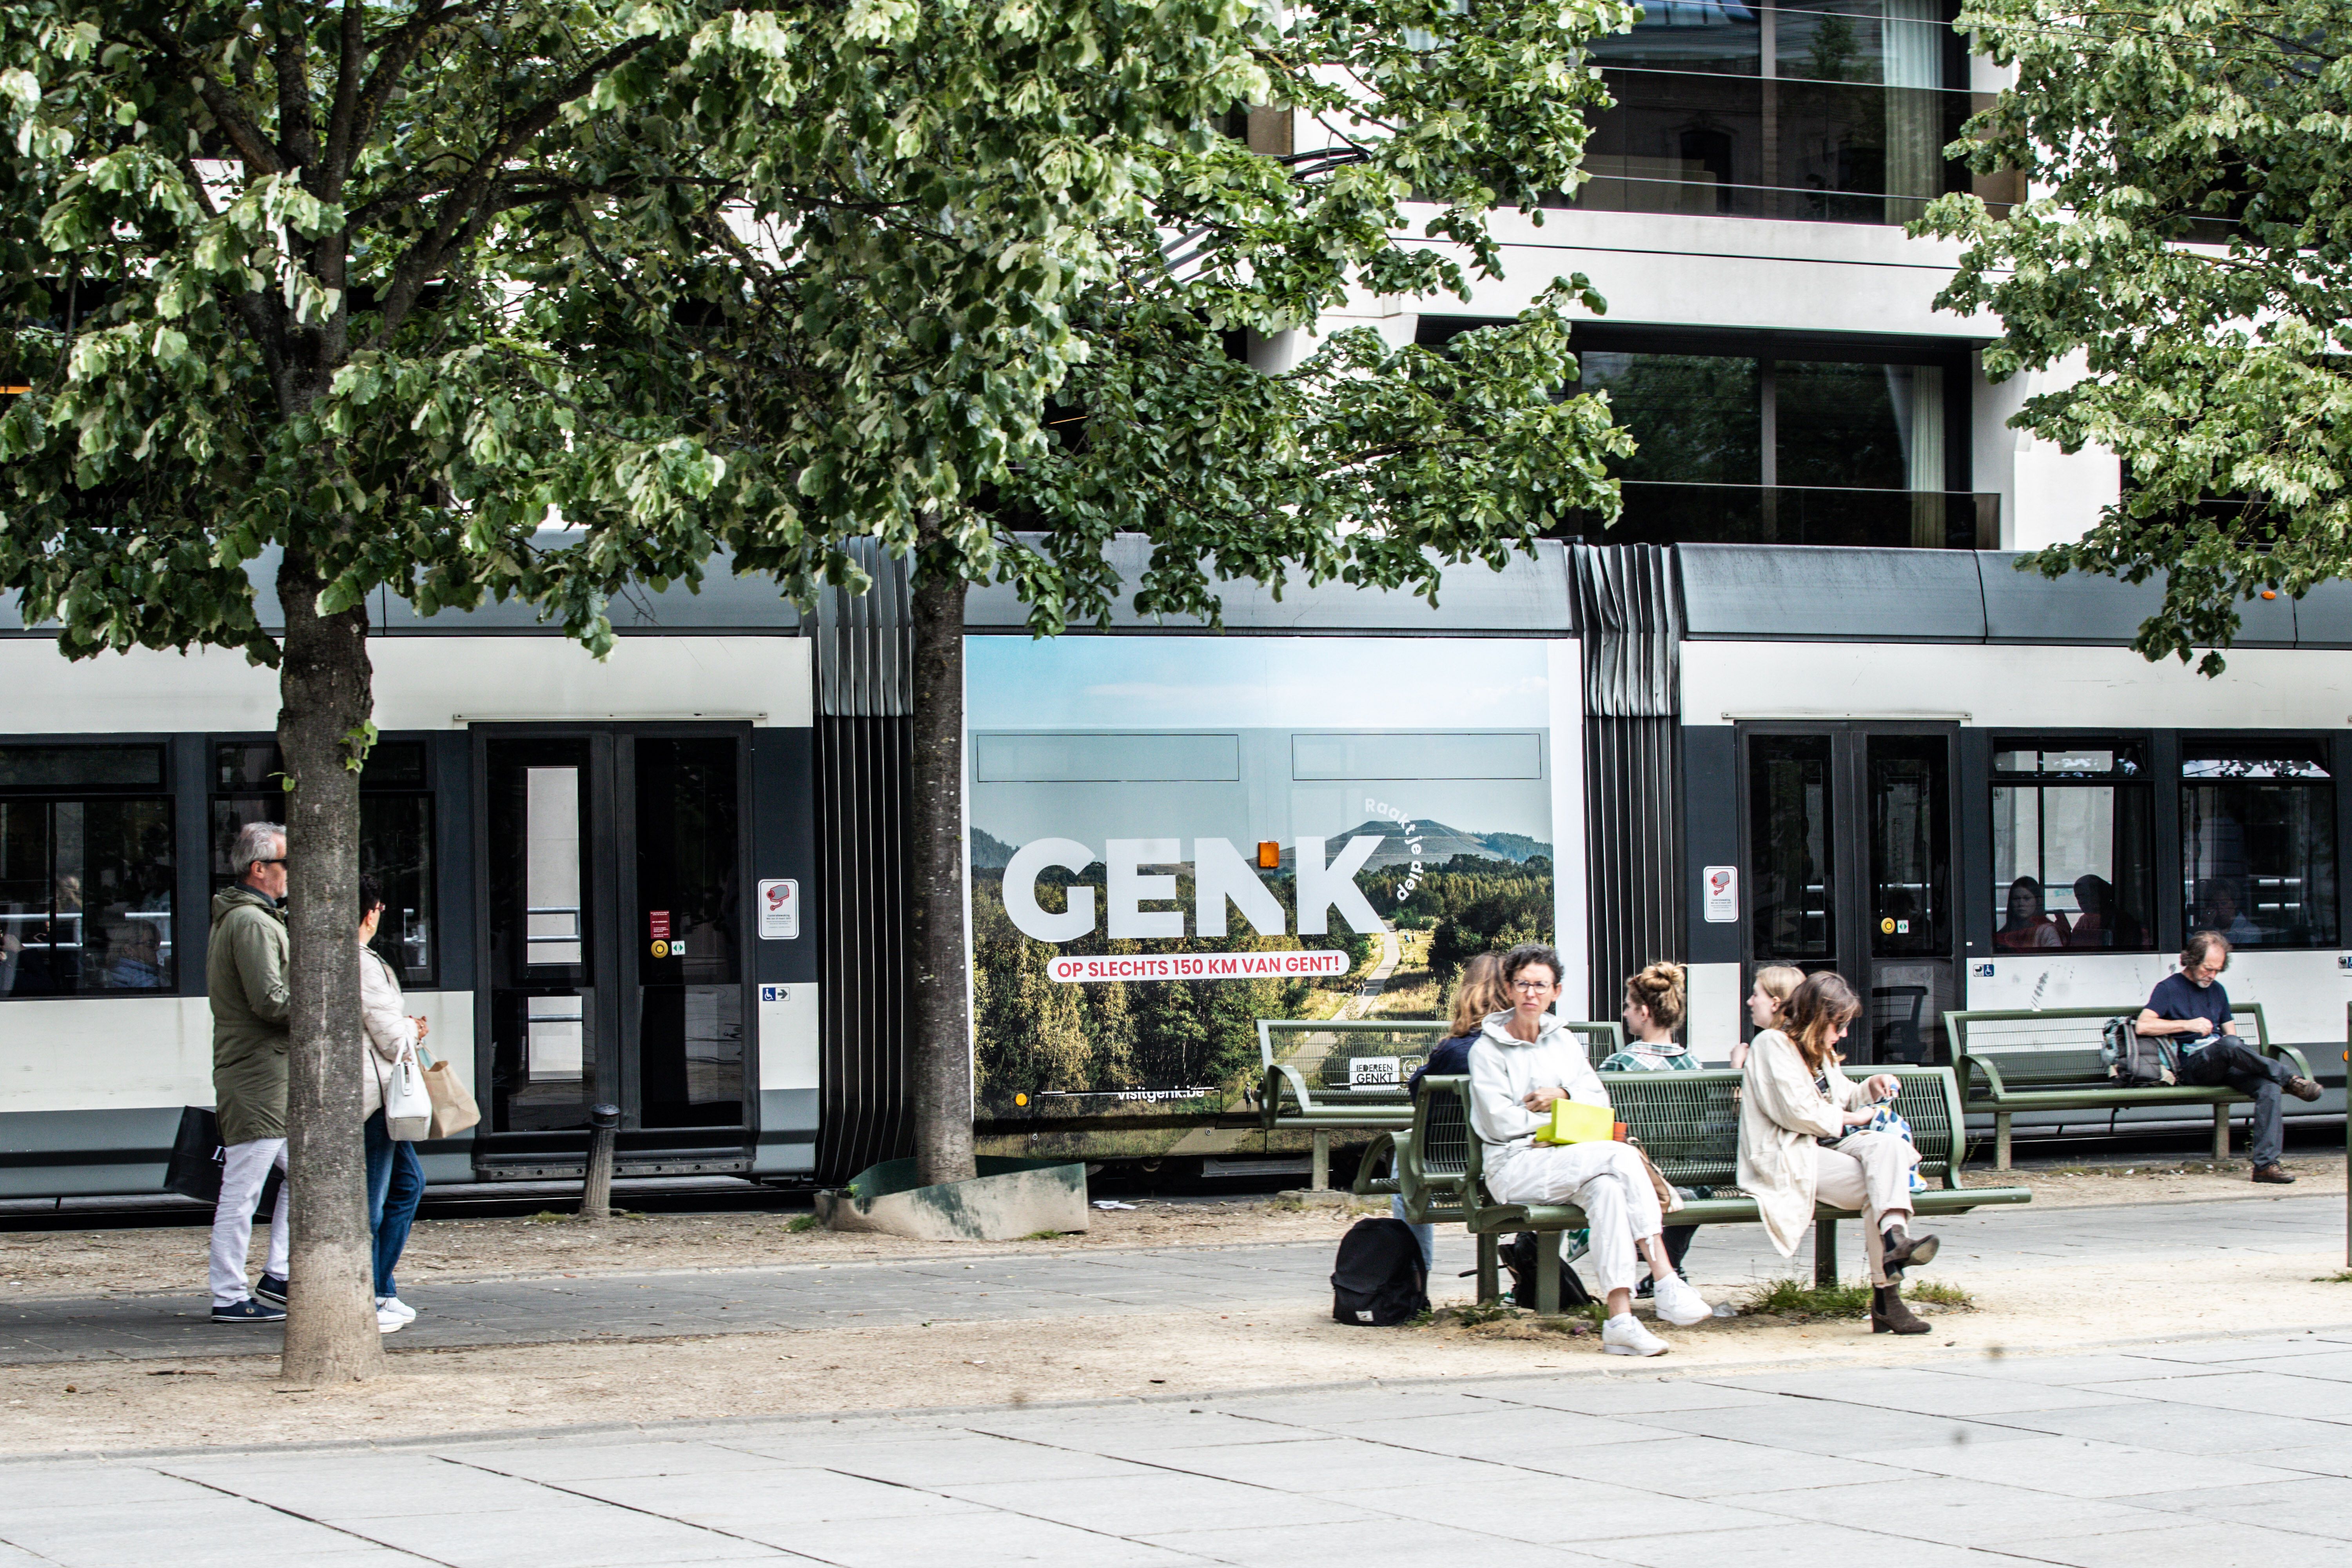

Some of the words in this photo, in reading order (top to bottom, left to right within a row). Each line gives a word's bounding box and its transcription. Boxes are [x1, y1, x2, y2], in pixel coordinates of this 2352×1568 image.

[1365, 798, 1416, 836] Raakt
[1404, 835, 1423, 855] je
[1002, 835, 1390, 943] GENK
[1397, 860, 1424, 901] diep
[1057, 962, 1083, 977] OP
[1088, 960, 1169, 977] SLECHTS
[1173, 958, 1203, 975] 150
[1208, 959, 1237, 974] KM
[1241, 958, 1281, 973] VAN
[1285, 956, 1339, 972] GENT!
[1356, 1063, 1393, 1072] IEDEREEN
[1356, 1073, 1393, 1083] GENKT
[1117, 1085, 1205, 1103] visitgenk.be
